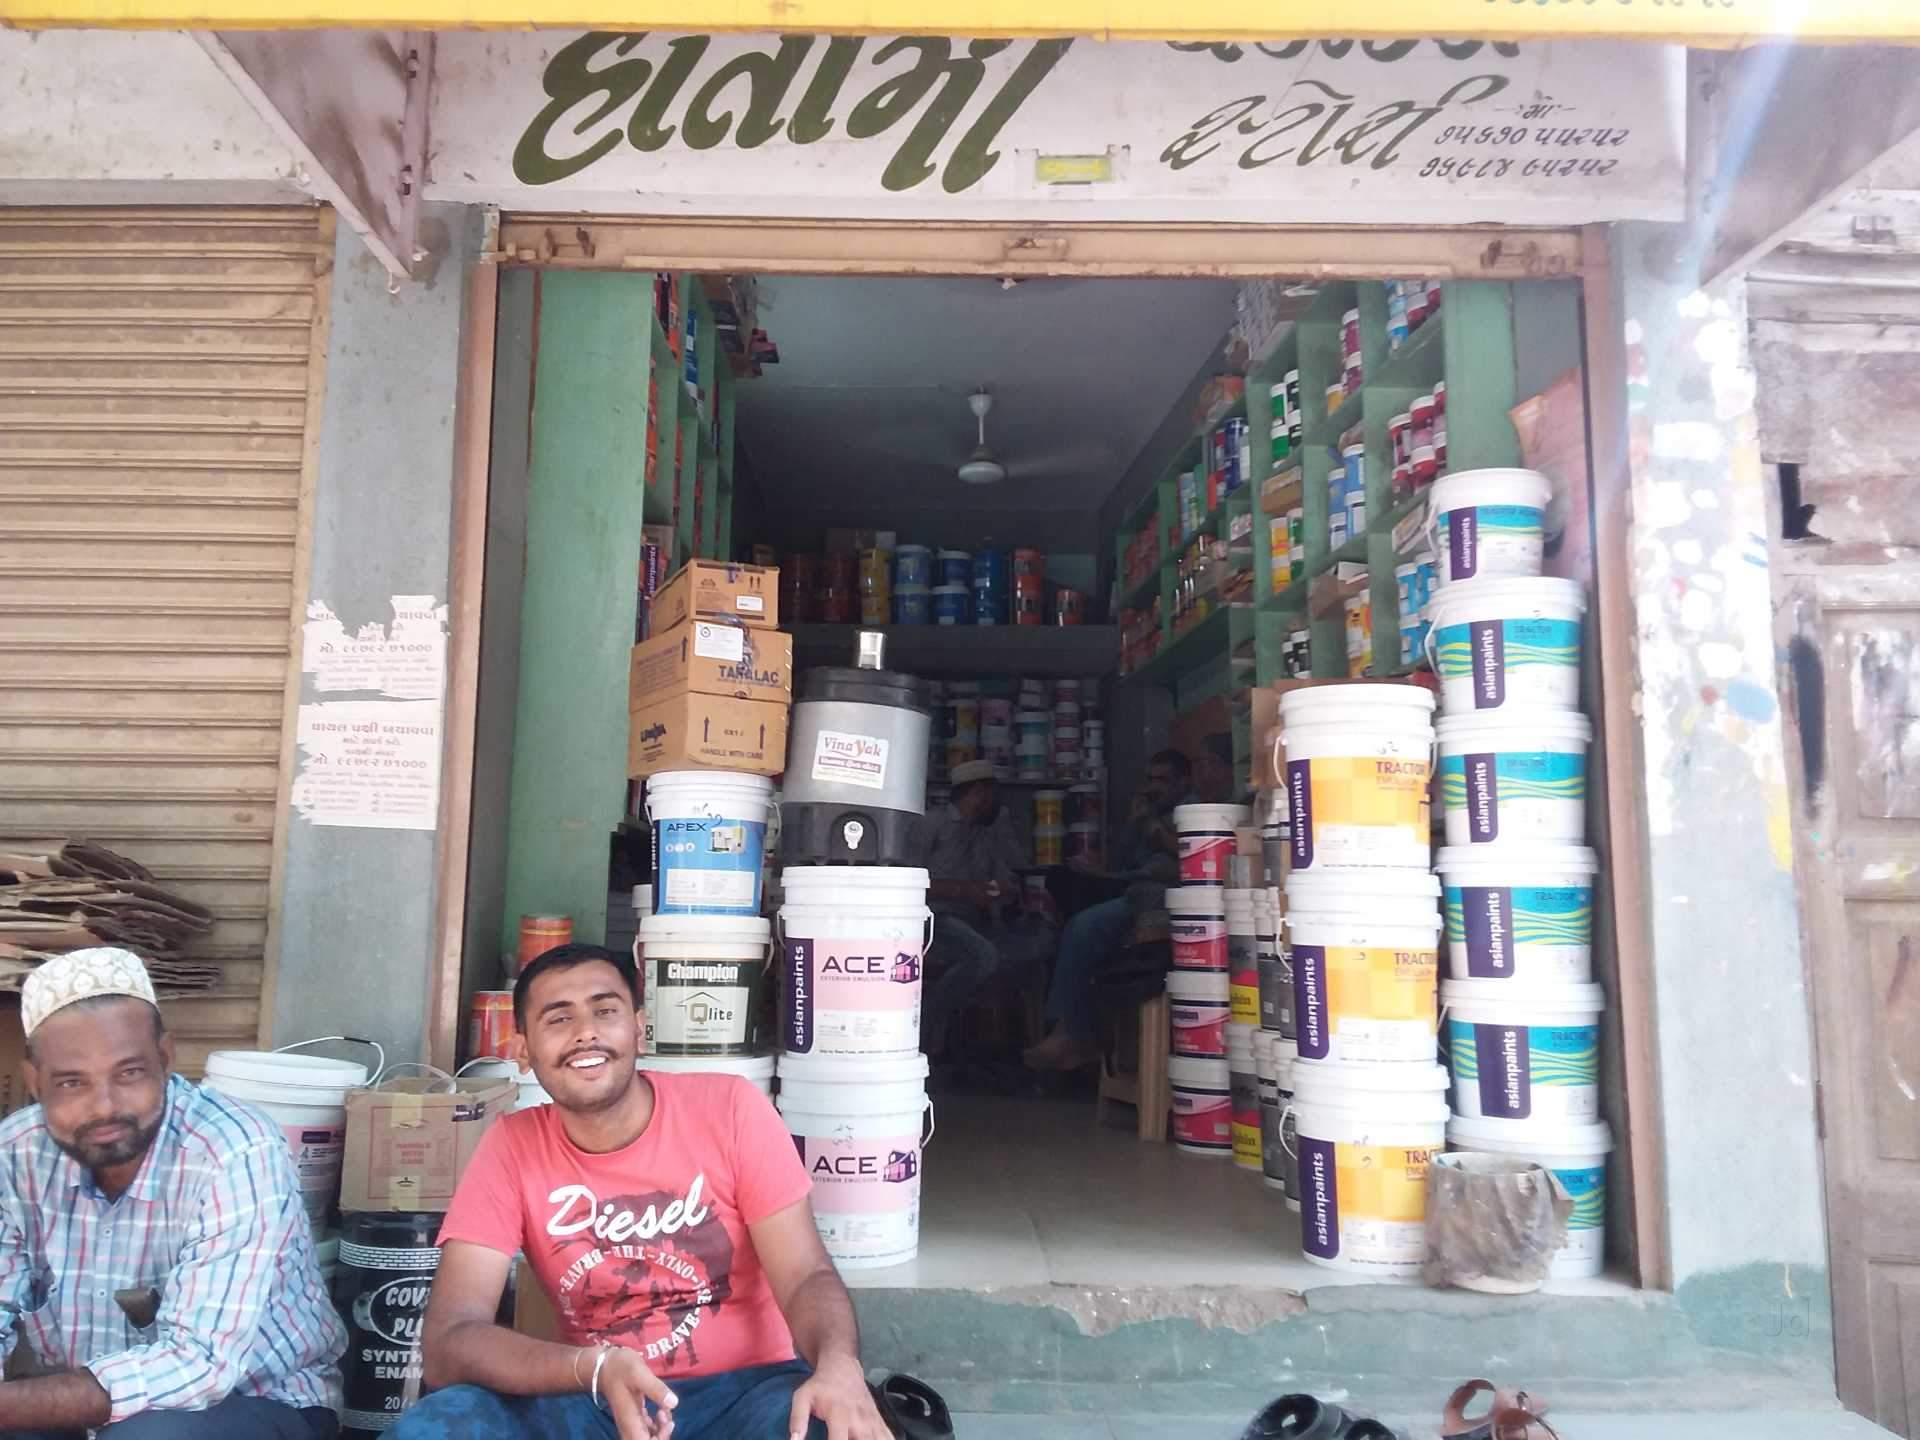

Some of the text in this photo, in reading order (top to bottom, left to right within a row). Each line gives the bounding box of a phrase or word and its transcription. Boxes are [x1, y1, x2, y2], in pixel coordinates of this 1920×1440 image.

[1462, 517, 1473, 568] asianpaints
[1484, 629, 1498, 699] asianpaints
[666, 823, 706, 832] APEX
[1293, 772, 1307, 857] asianpaints
[1477, 761, 1493, 834] asianpaints
[821, 955, 885, 973] ACE
[1489, 892, 1505, 968] asianpaints
[667, 962, 739, 983] Champion
[793, 945, 808, 1046] asianpaints
[1304, 957, 1320, 1047] asianpaints
[1505, 1030, 1522, 1109] asianpaints
[813, 1156, 877, 1174] ACE
[1312, 1152, 1331, 1246] asianpaints
[547, 1172, 708, 1242] Diesel
[646, 1311, 698, 1360] BRAVE
